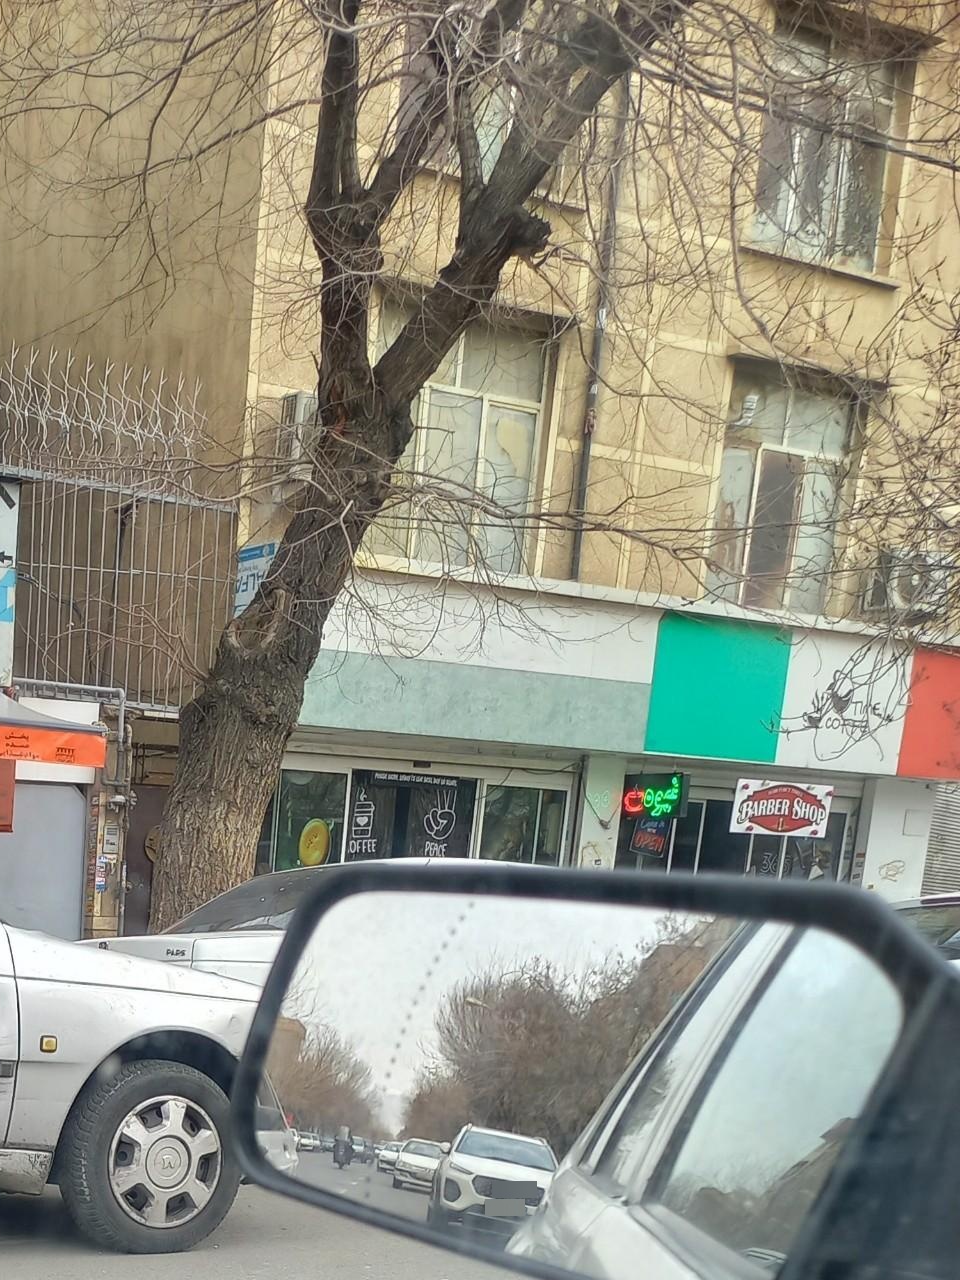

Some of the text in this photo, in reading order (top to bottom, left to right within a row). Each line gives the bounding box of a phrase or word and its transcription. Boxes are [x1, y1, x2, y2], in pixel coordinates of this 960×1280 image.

[737, 797, 826, 826] BARBER SHOP
[348, 839, 377, 854] OFFEE
[424, 841, 448, 857] PEACE
